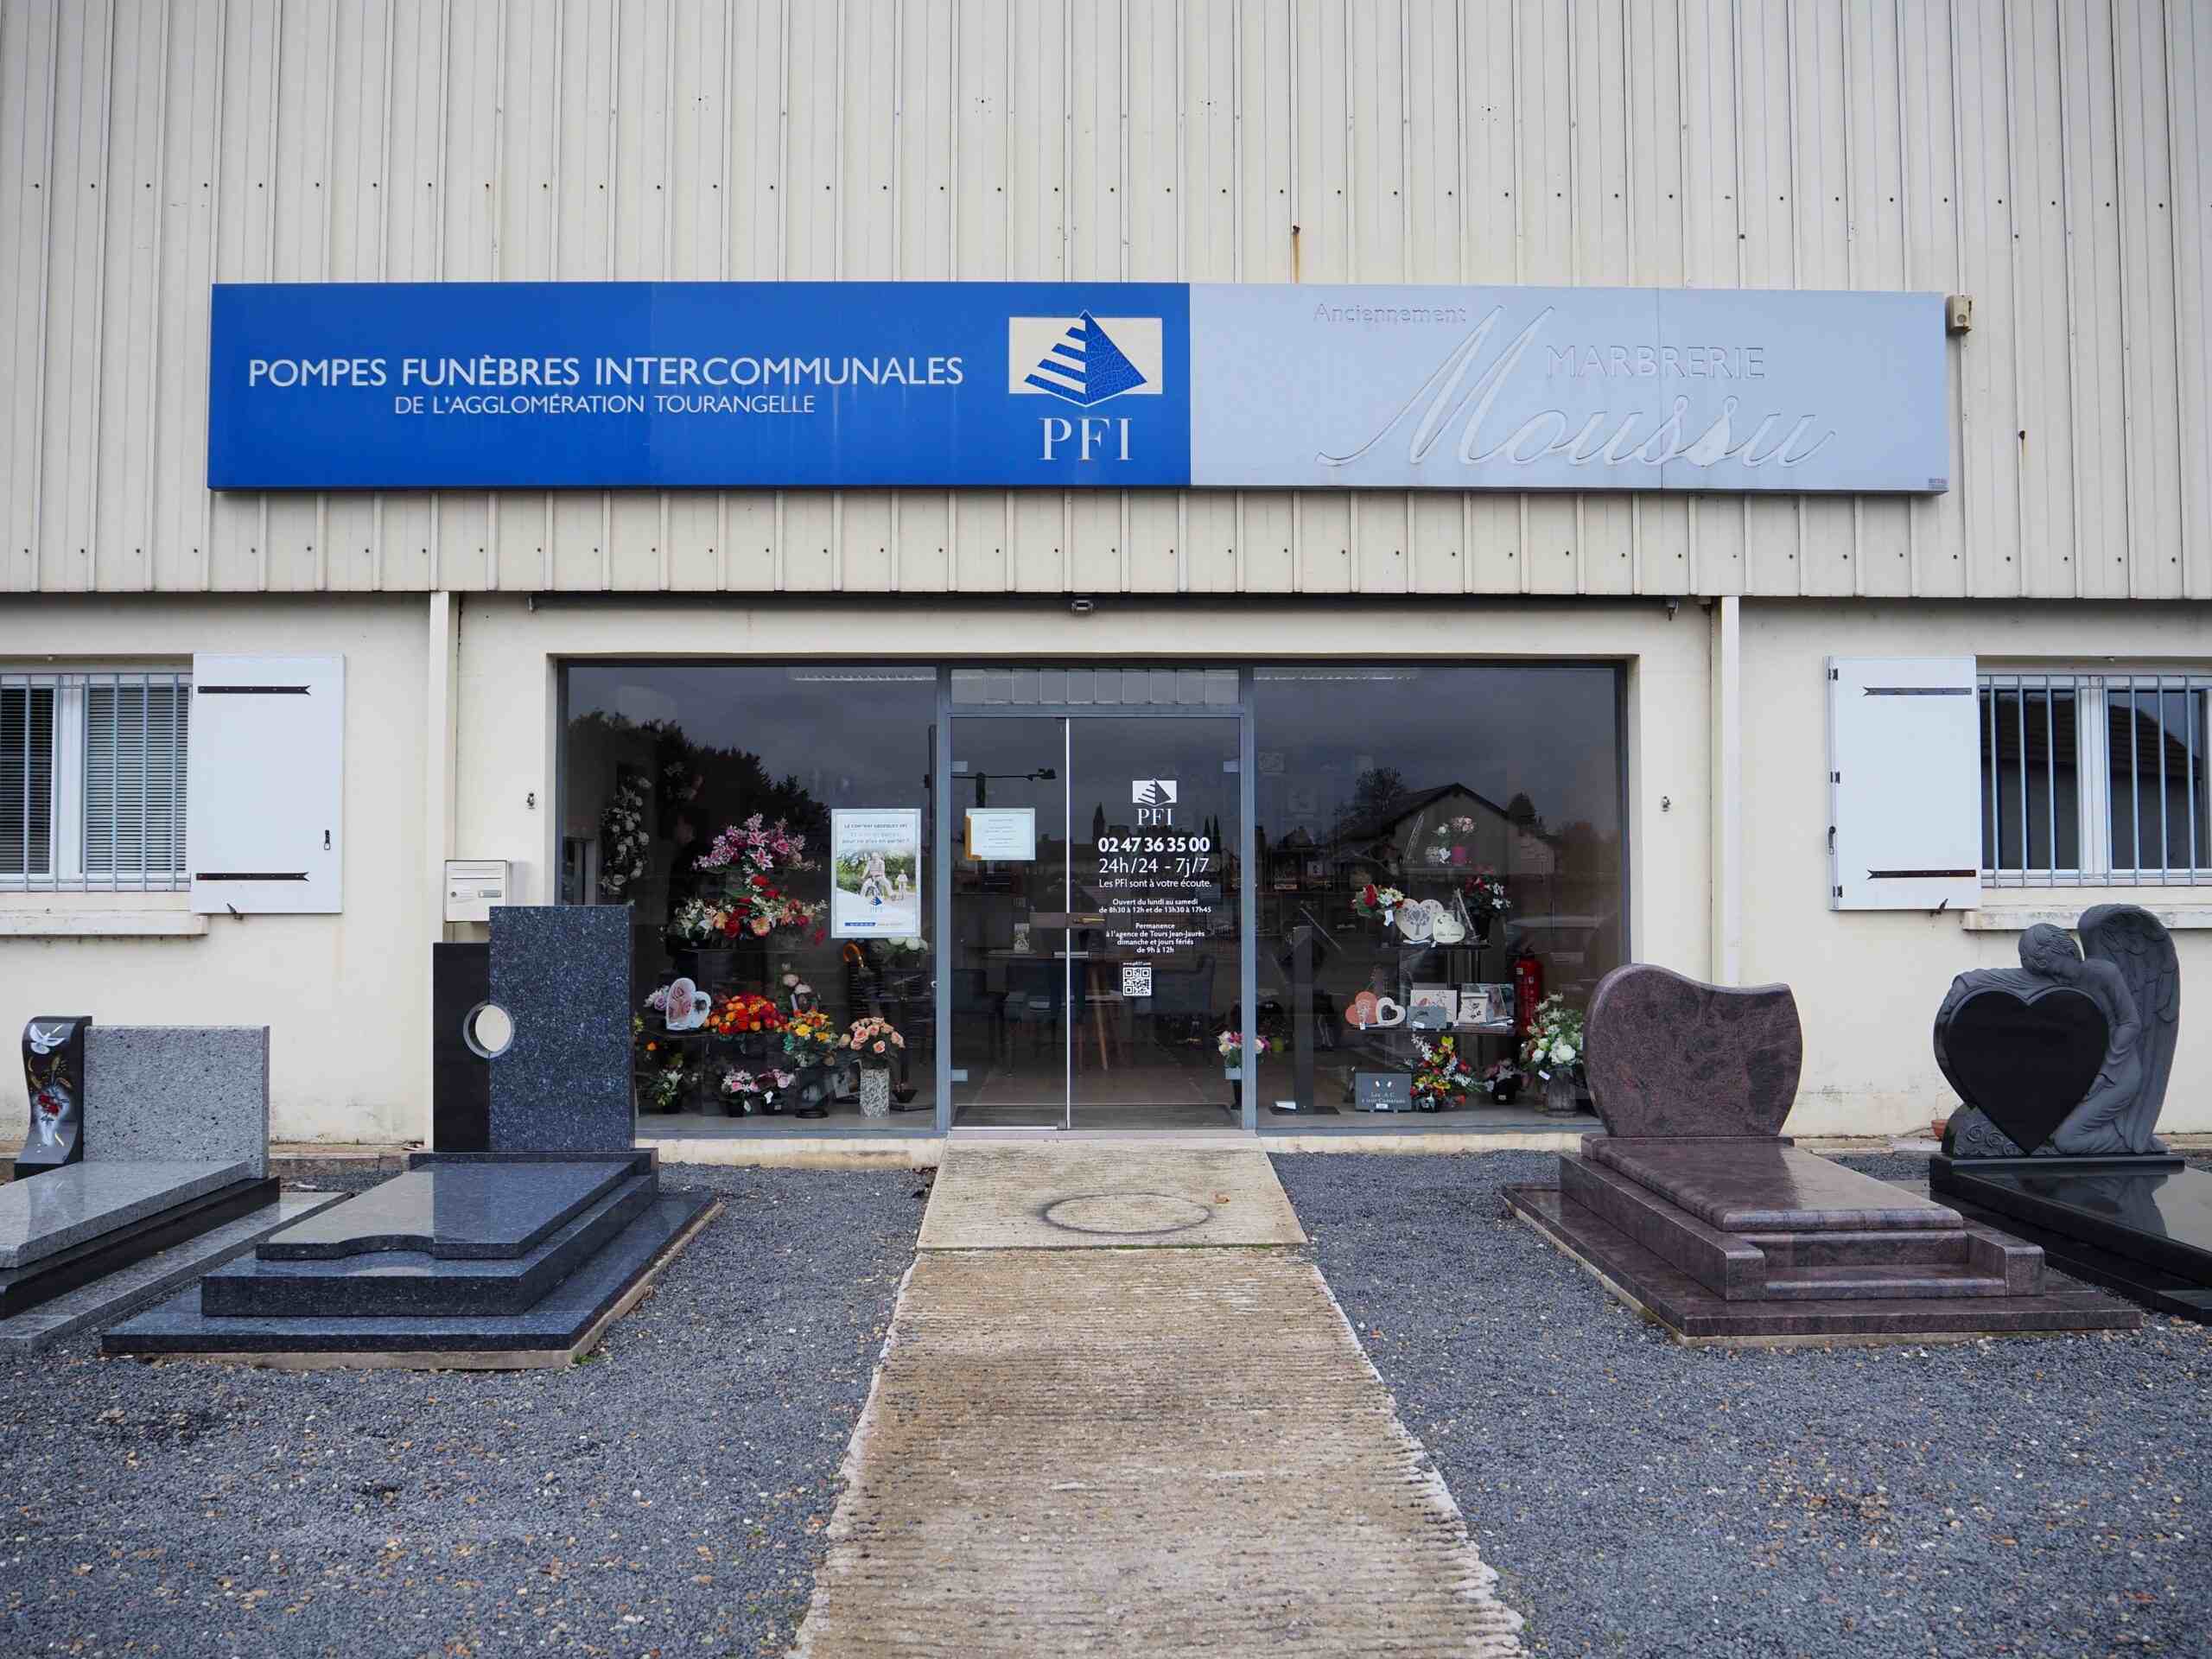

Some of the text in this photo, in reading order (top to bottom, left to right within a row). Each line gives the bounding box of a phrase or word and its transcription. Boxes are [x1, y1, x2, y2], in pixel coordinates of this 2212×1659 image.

[1314, 302, 1468, 324] Anciennement
[248, 354, 964, 388] POMPES FUNÈBRES INTERCOMMUNALES
[1546, 346, 1766, 380] MARBRERIE
[1316, 305, 1838, 467] Moussu
[395, 394, 815, 415] DE L'AGGLOMÉRATION TOURANGELLE
[1040, 416, 1133, 461] PFI
[1136, 808, 1173, 826] PFI
[1097, 836, 1211, 853] 02 47 36 35 00
[1098, 856, 1159, 874] 24h/24
[1175, 857, 1210, 878] 7j/7
[1098, 877, 1212, 888] Les PFI sont à votre écoute.
[1110, 930, 1139, 940] l'agence
[1157, 938, 1175, 947] jours
